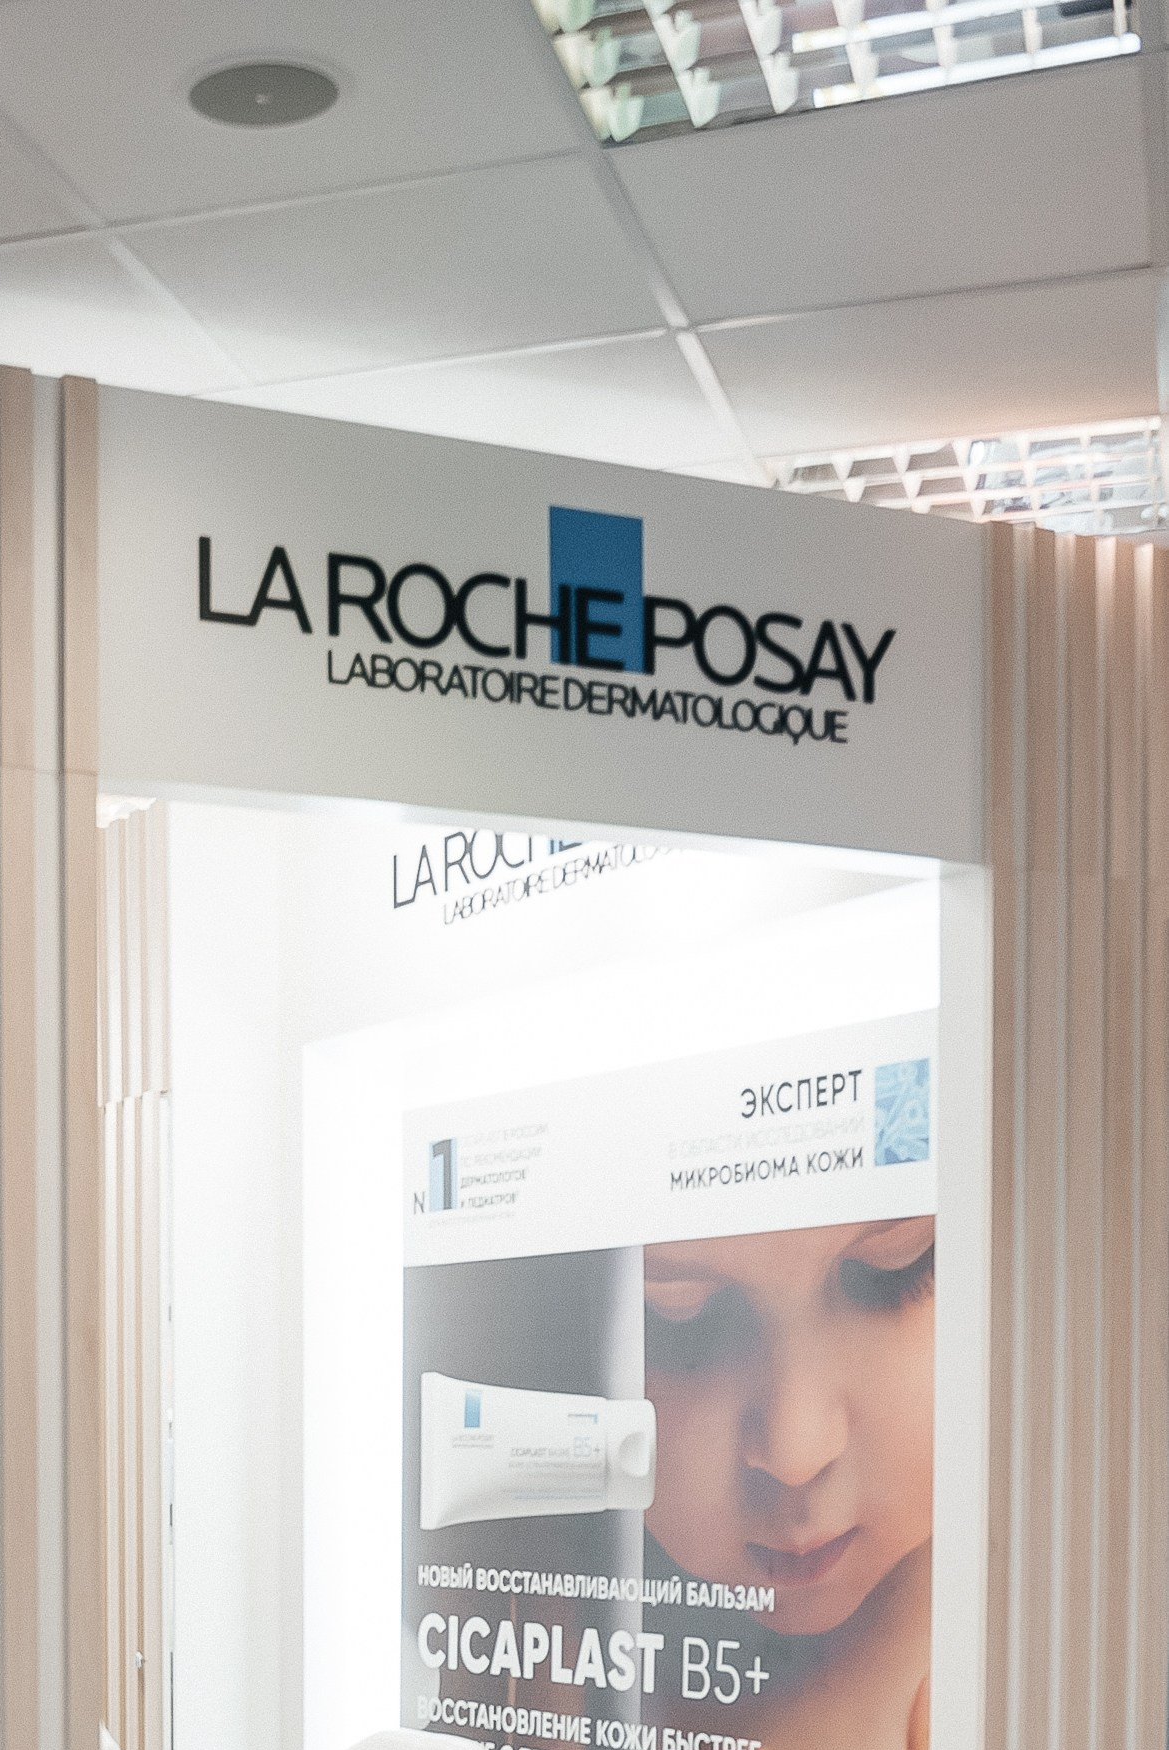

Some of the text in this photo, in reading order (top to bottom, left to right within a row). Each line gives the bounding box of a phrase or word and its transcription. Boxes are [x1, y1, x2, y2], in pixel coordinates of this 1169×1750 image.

[199, 536, 897, 704] LA ROCHE POSAY
[327, 650, 849, 745] LABORATOIRE DERMATOLOGIQUE
[392, 844, 437, 909] LA
[739, 1067, 864, 1120] ЭКСПЕРТ
[669, 1145, 865, 1192] МИКРОБИОМА КОЖИ
[417, 1562, 775, 1612] НОВЫЙ ВОССТАНАВЛИВАЮЩИЙ БАЛЬЗАМ
[417, 1612, 770, 1704] CICAPLAST B5+
[416, 1696, 592, 1745] ВОССТАНОВЛЕНИЕ
